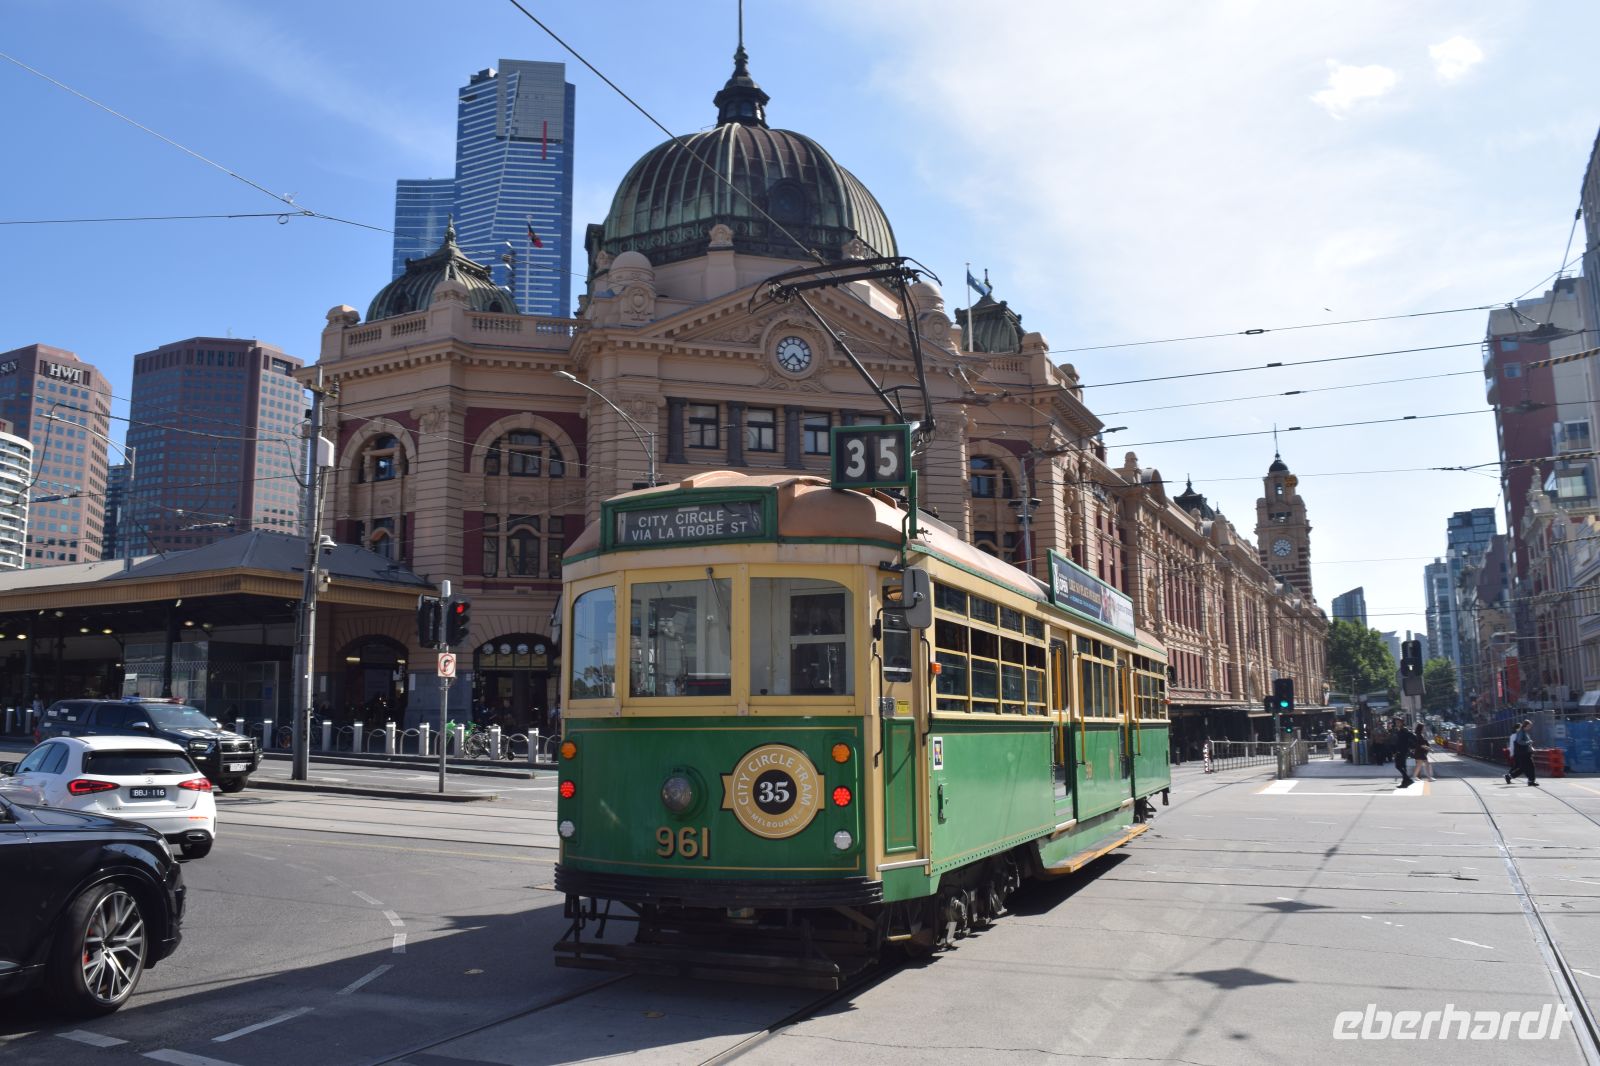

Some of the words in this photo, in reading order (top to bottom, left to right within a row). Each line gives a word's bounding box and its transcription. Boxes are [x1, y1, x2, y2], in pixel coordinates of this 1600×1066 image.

[50, 363, 82, 381] HWT
[638, 515, 668, 528] CITY
[675, 510, 724, 525] CIRCLE
[632, 529, 651, 541] VIA
[658, 528, 675, 539] LA
[679, 523, 724, 537] TROBE
[730, 521, 748, 534] ST
[738, 772, 750, 805] CITY
[748, 753, 795, 772] CIRCLE
[795, 764, 812, 806] TRAM
[759, 781, 790, 803] 35
[751, 813, 799, 828] MELBOURNE
[656, 827, 709, 857] 961
